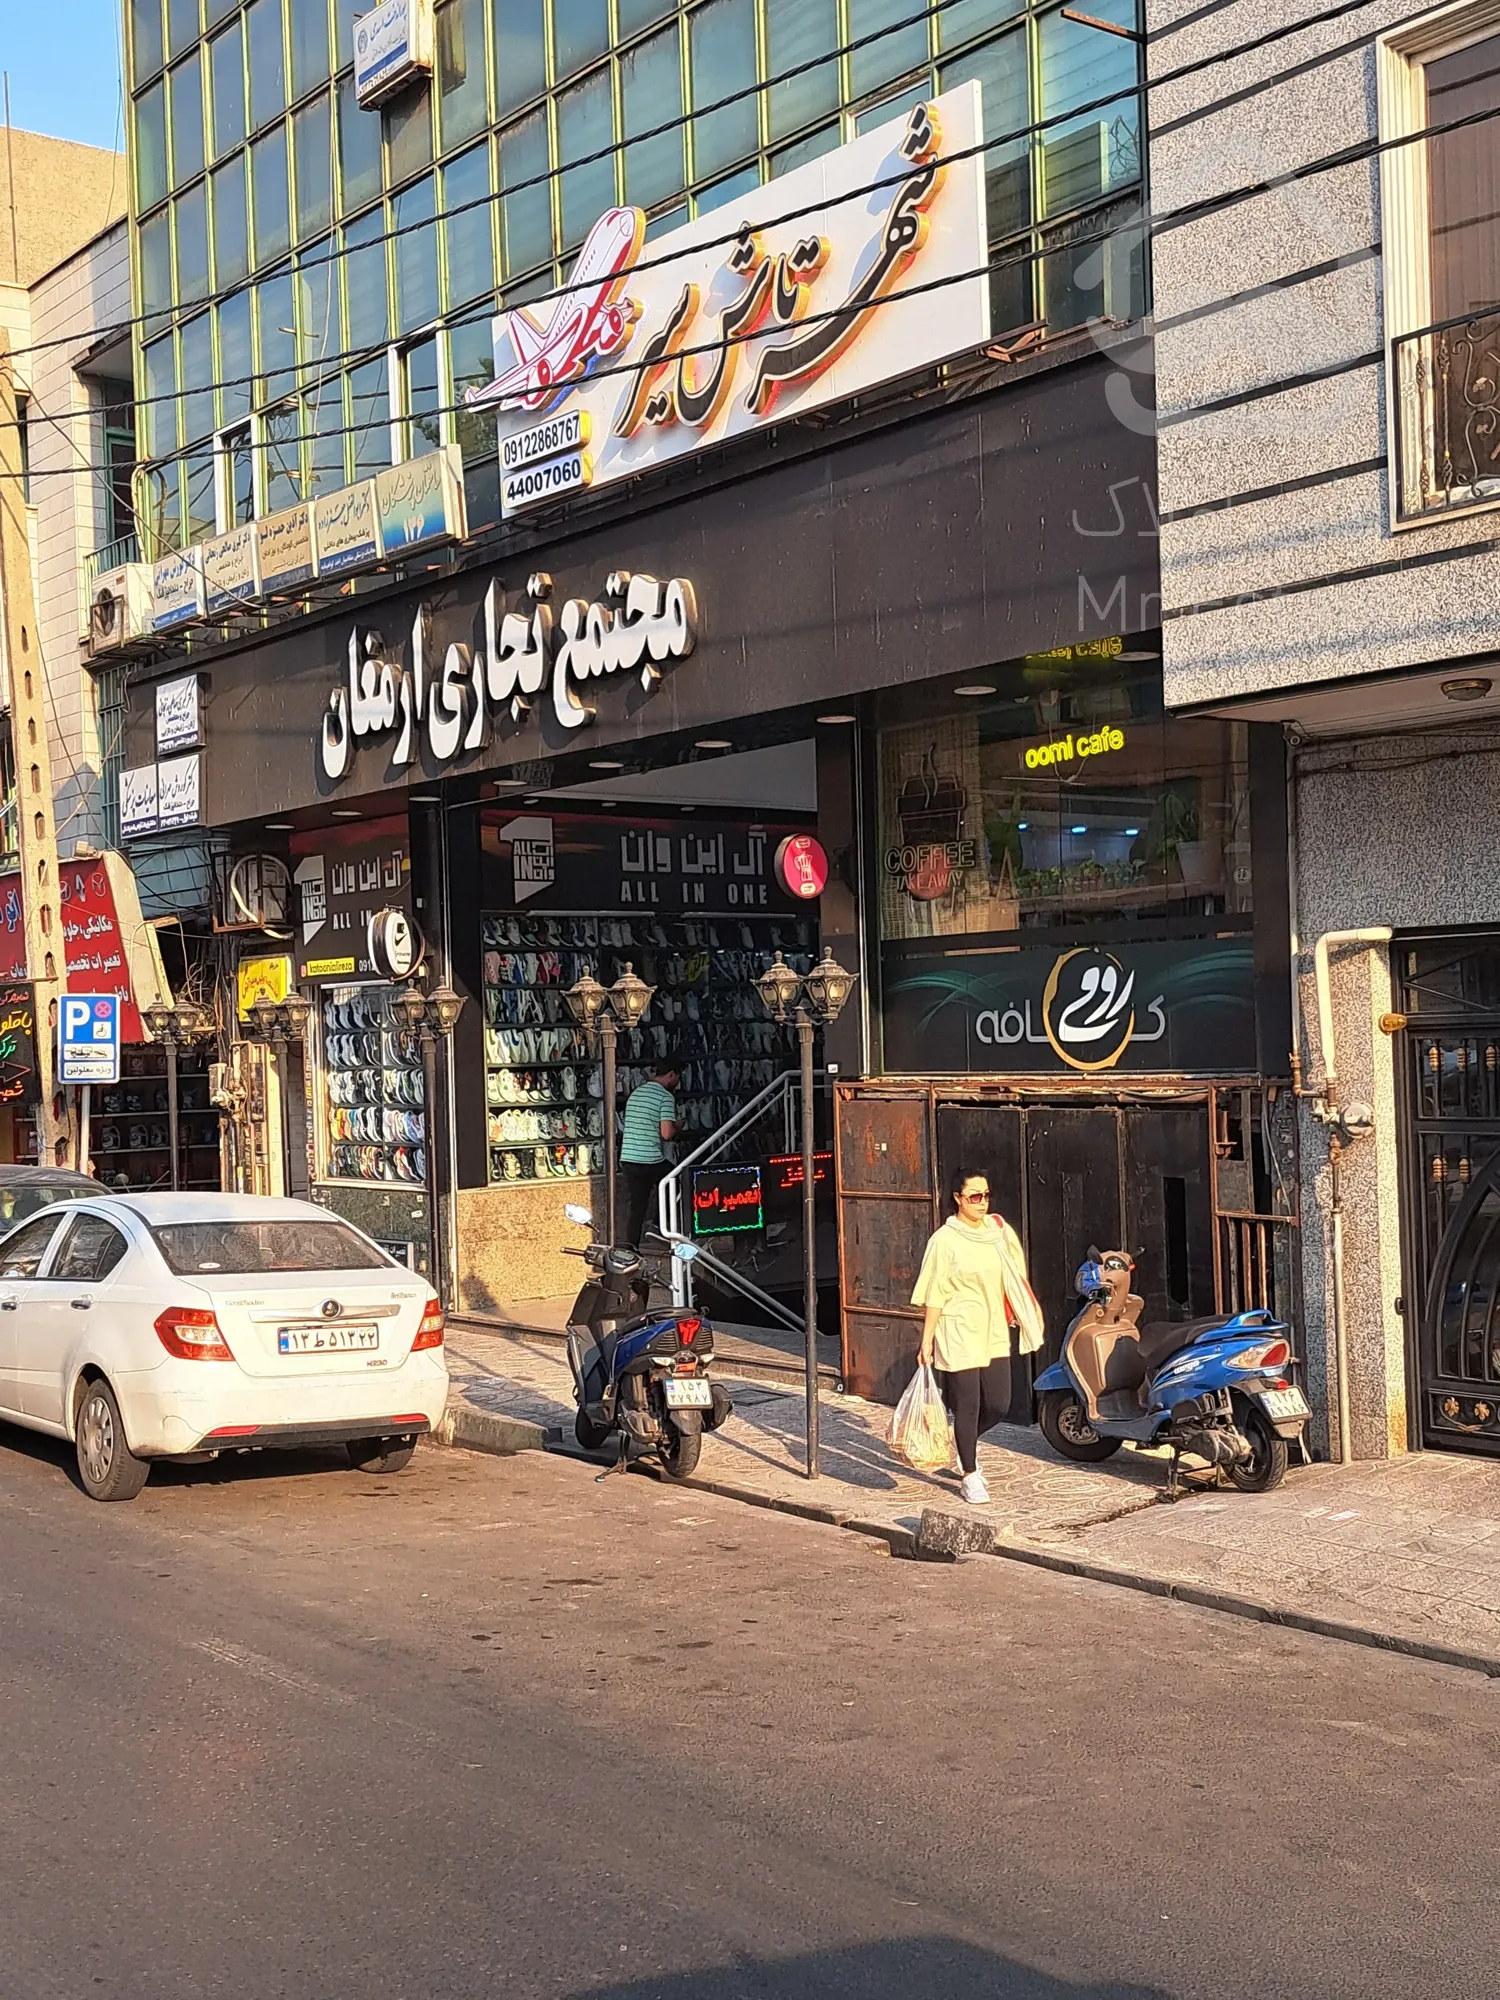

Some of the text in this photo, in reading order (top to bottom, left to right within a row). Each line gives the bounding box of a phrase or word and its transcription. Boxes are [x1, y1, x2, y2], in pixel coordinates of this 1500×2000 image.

[504, 414, 580, 466] 09122868767
[507, 458, 581, 500] 44007060
[322, 573, 694, 778] مجتمع تجاری ارمغان
[1076, 725, 1124, 757] cafe
[621, 830, 767, 875] آل این وان
[884, 840, 975, 874] COFFEE
[332, 850, 402, 895] آل این وان
[893, 869, 964, 891] TAKE AWAY
[620, 880, 768, 904] ALL IN ONE
[333, 912, 351, 930] ALL
[0, 1010, 32, 1036] باقلو
[66, 1001, 91, 1040] P
[66, 1067, 112, 1076] ویژه معلولین
